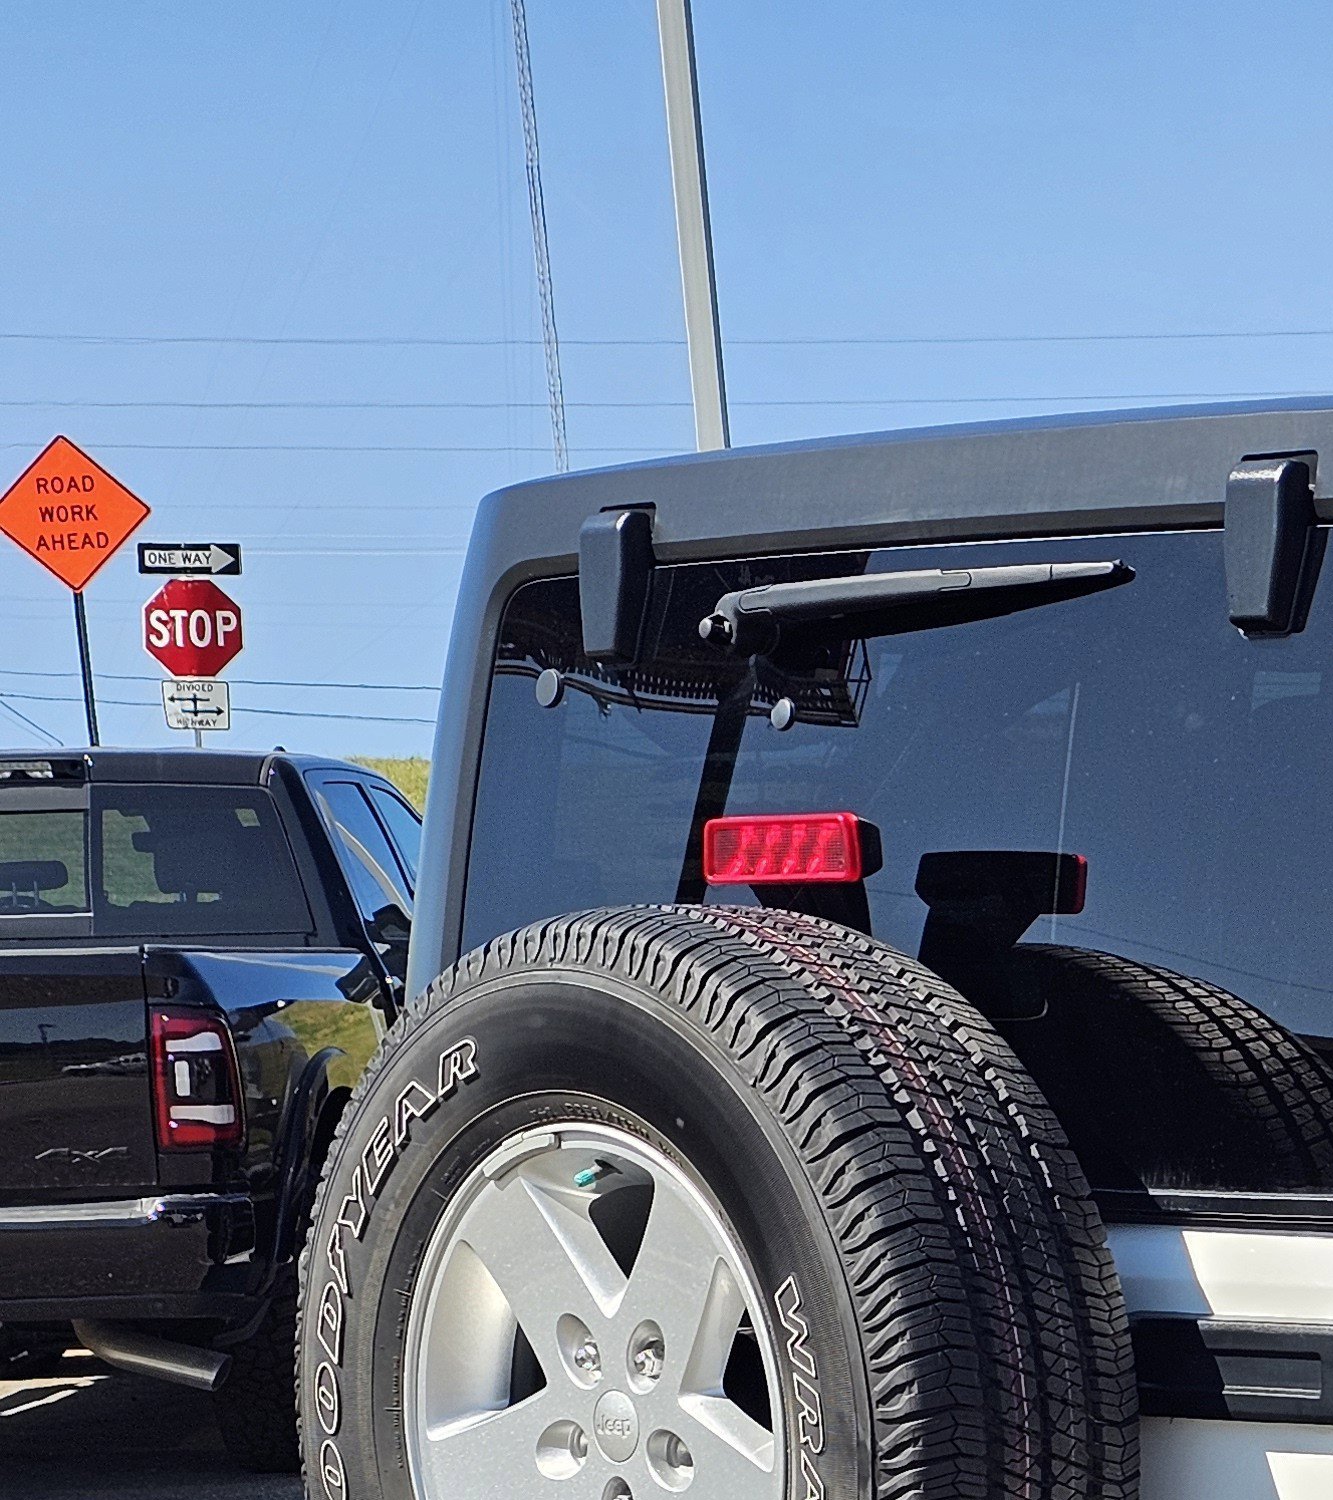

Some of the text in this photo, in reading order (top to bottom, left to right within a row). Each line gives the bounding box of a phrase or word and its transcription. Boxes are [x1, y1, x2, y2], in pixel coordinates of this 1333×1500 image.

[36, 475, 95, 494] ROAD
[39, 504, 98, 523] WORK
[36, 532, 110, 551] AHEAD
[148, 552, 212, 566] ONE WAY
[149, 609, 237, 648] STOP
[176, 684, 214, 692] DIVIDED
[597, 1414, 630, 1437] Jeep
